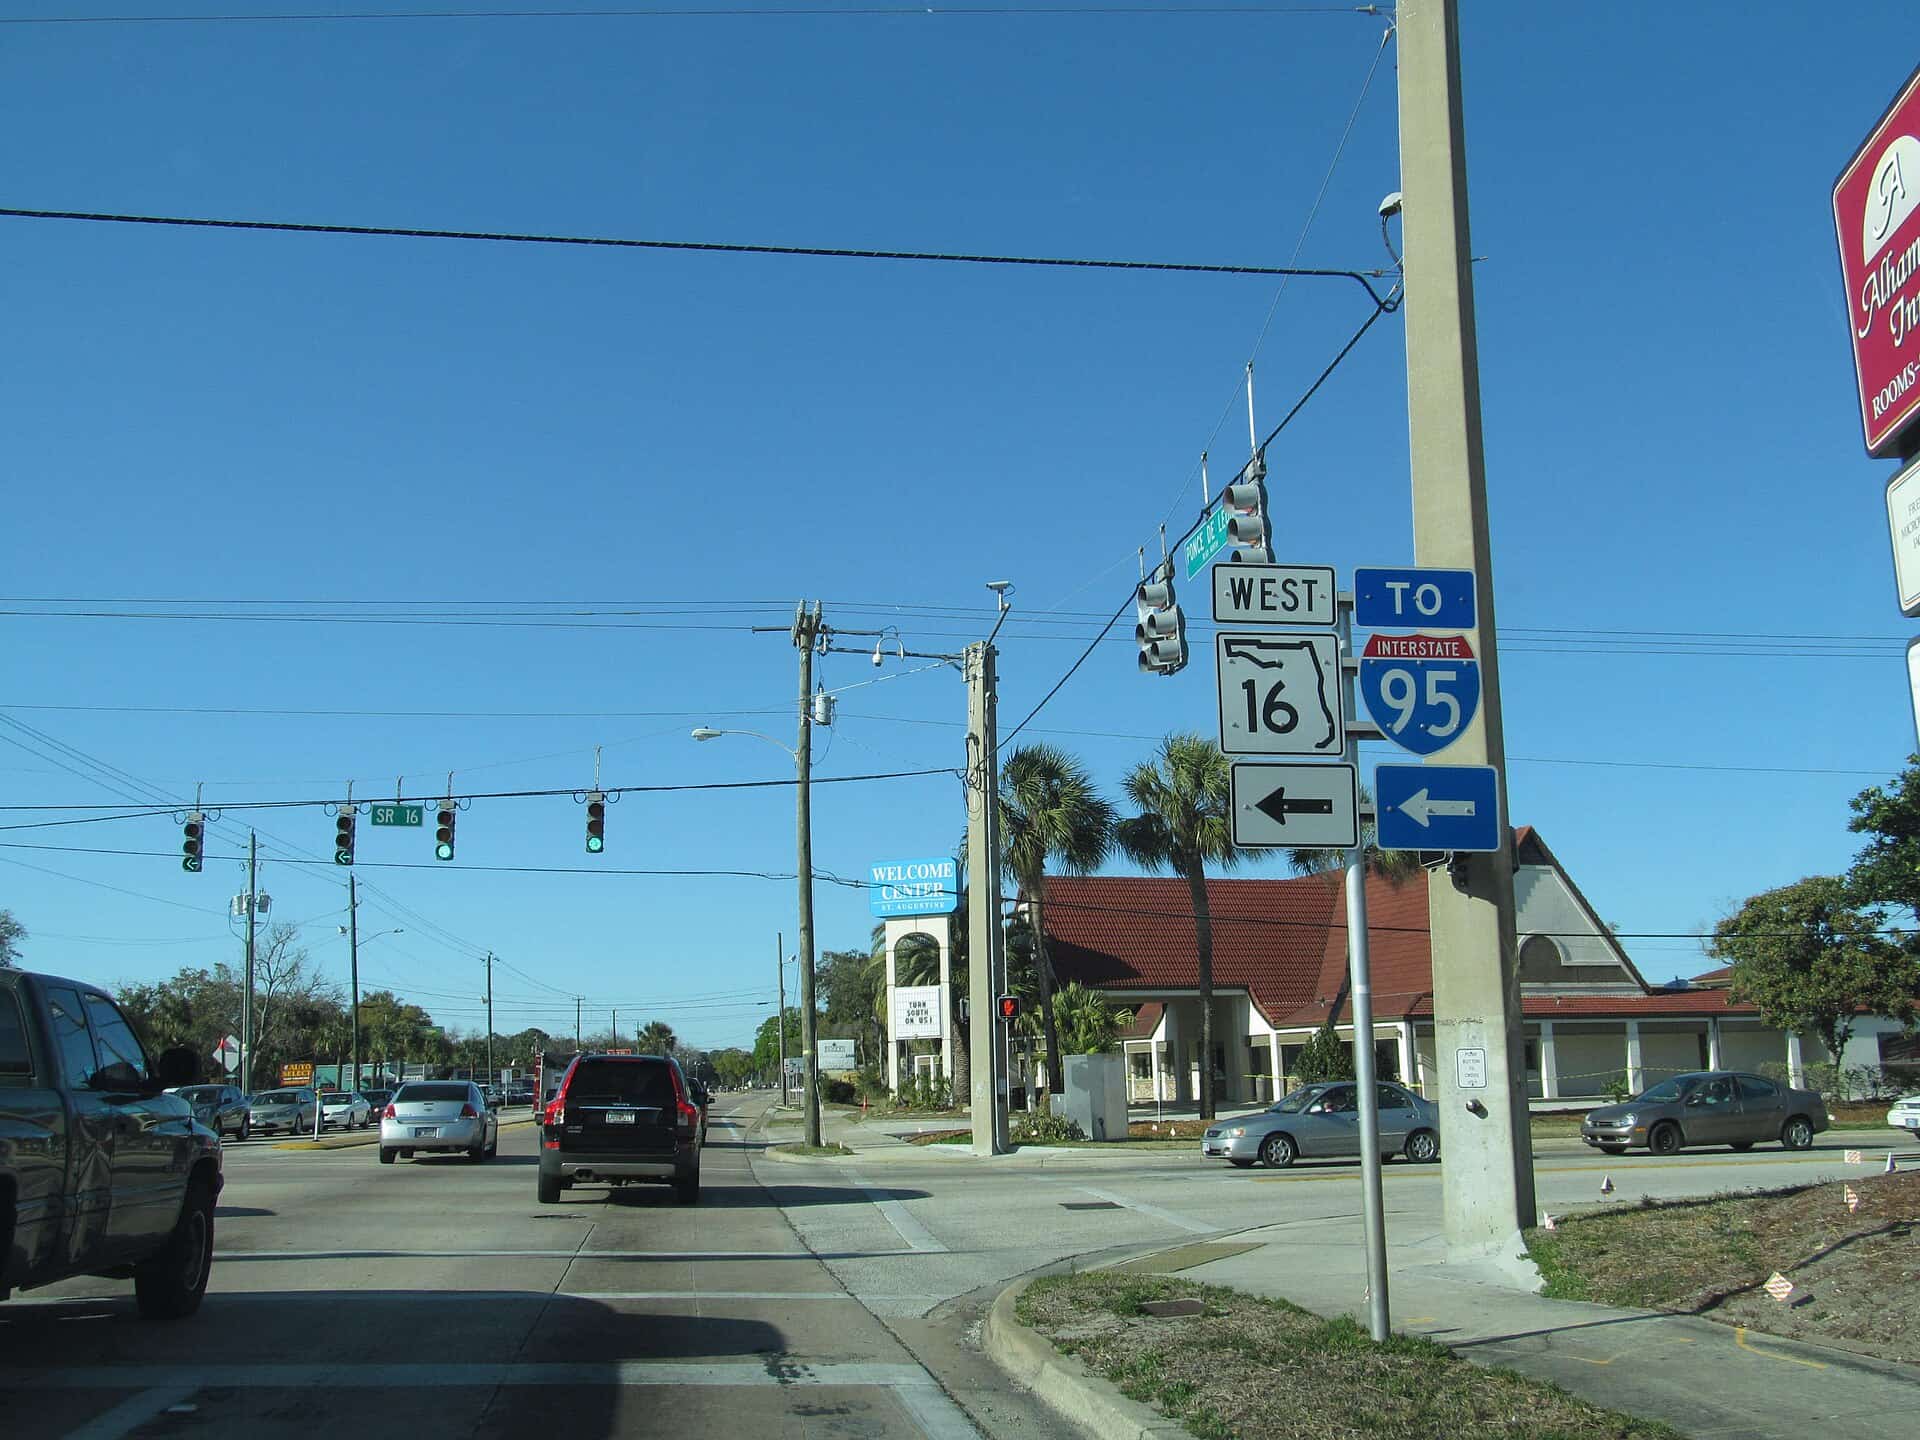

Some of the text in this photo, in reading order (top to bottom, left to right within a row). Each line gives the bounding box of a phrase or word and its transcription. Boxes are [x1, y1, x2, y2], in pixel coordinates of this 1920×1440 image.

[1889, 292, 1920, 347] In
[1186, 532, 1205, 565] PONCE
[1206, 520, 1216, 545] DE
[1230, 577, 1318, 611] WEST
[1385, 581, 1442, 615] TO
[1377, 641, 1460, 657] INTERSTATE
[1241, 678, 1299, 734] 16
[1380, 668, 1461, 737] 95
[376, 808, 419, 824] SR 16
[872, 863, 953, 881] WELCOME
[882, 882, 944, 900] CENTER
[897, 901, 944, 910] AUGUSTINE
[907, 1009, 929, 1017] SOUTH
[287, 1063, 312, 1071] AUTO
